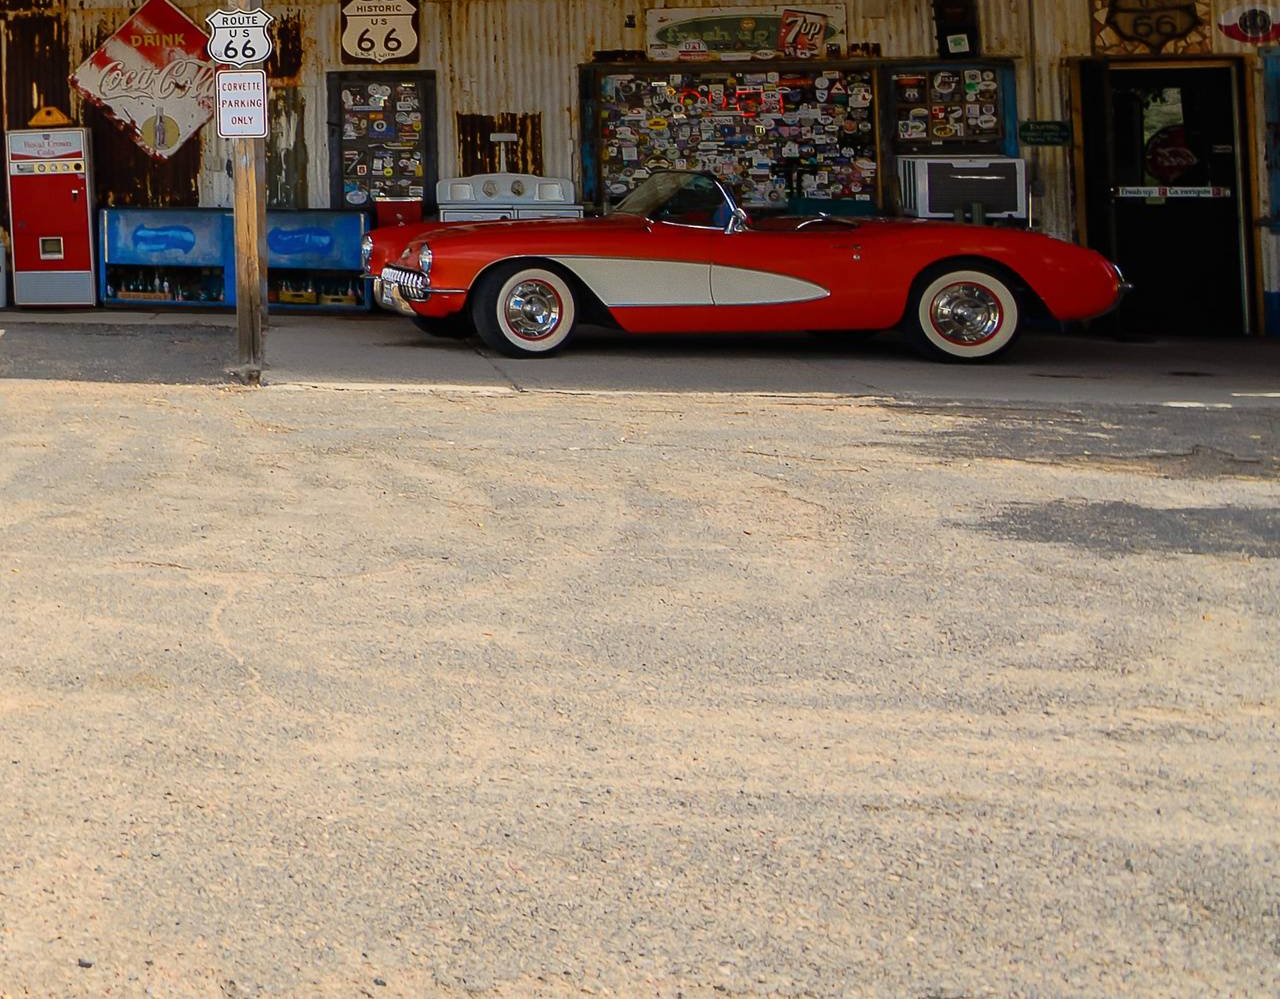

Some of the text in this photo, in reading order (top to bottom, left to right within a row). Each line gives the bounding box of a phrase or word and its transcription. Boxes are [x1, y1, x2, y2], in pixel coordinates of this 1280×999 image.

[356, 4, 402, 14] HISTORIC
[222, 15, 258, 26] ROUTE
[130, 33, 186, 47] DRINK
[357, 27, 402, 53] 66
[223, 39, 257, 59] 66
[222, 82, 261, 92] CORVETTE
[221, 98, 262, 108] PARKING
[231, 116, 254, 126] ONLY
